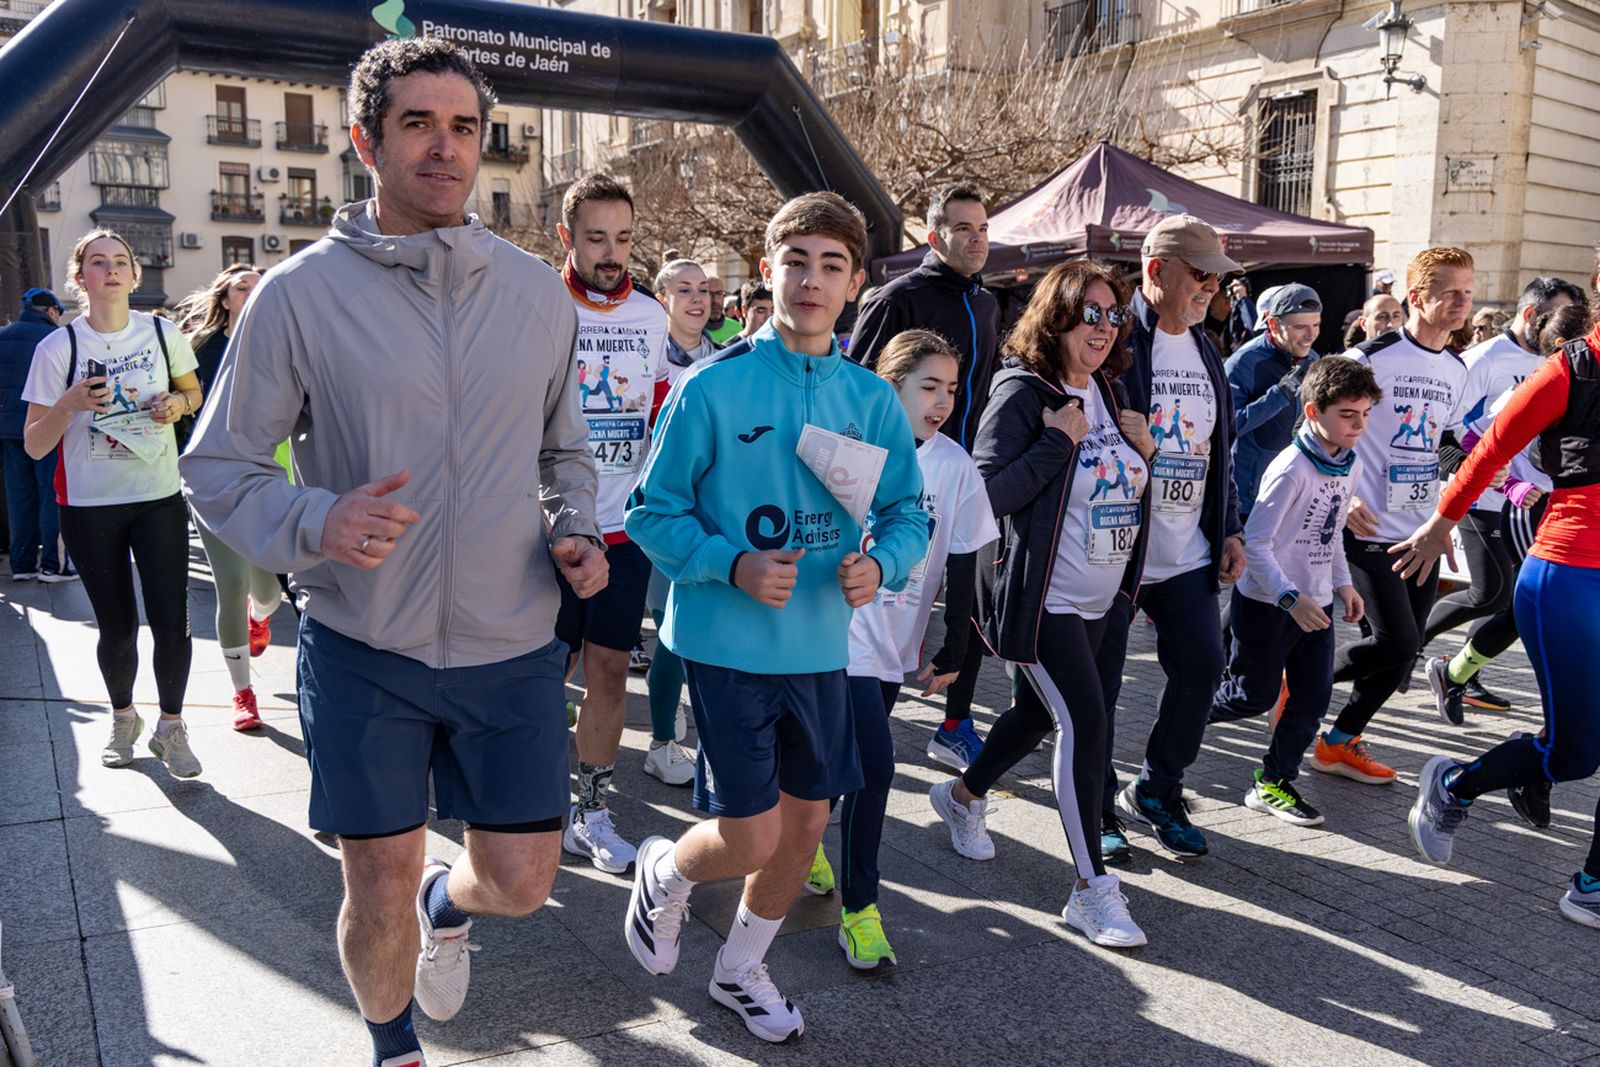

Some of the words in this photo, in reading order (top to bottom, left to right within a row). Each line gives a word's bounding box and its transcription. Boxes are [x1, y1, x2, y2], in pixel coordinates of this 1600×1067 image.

[422, 20, 505, 45] Patronato
[509, 31, 587, 56] Municipal
[591, 43, 611, 59] de
[505, 52, 526, 68] de
[530, 54, 569, 73] Jaén
[578, 325, 610, 335] RRERA
[596, 338, 635, 352] MUERTE
[108, 360, 139, 377] MUERTE
[1151, 369, 1180, 378] ARRERA
[1403, 375, 1433, 385] CARRERA
[1151, 382, 1168, 396] ENA
[1169, 382, 1202, 397] MUERTE
[1393, 385, 1420, 400] BUENA
[589, 430, 606, 439] UENA
[594, 441, 632, 463] 473
[1162, 480, 1194, 502] 180
[1409, 482, 1429, 501] 35
[1302, 497, 1320, 530] NEVER
[1110, 527, 1133, 552] 182
